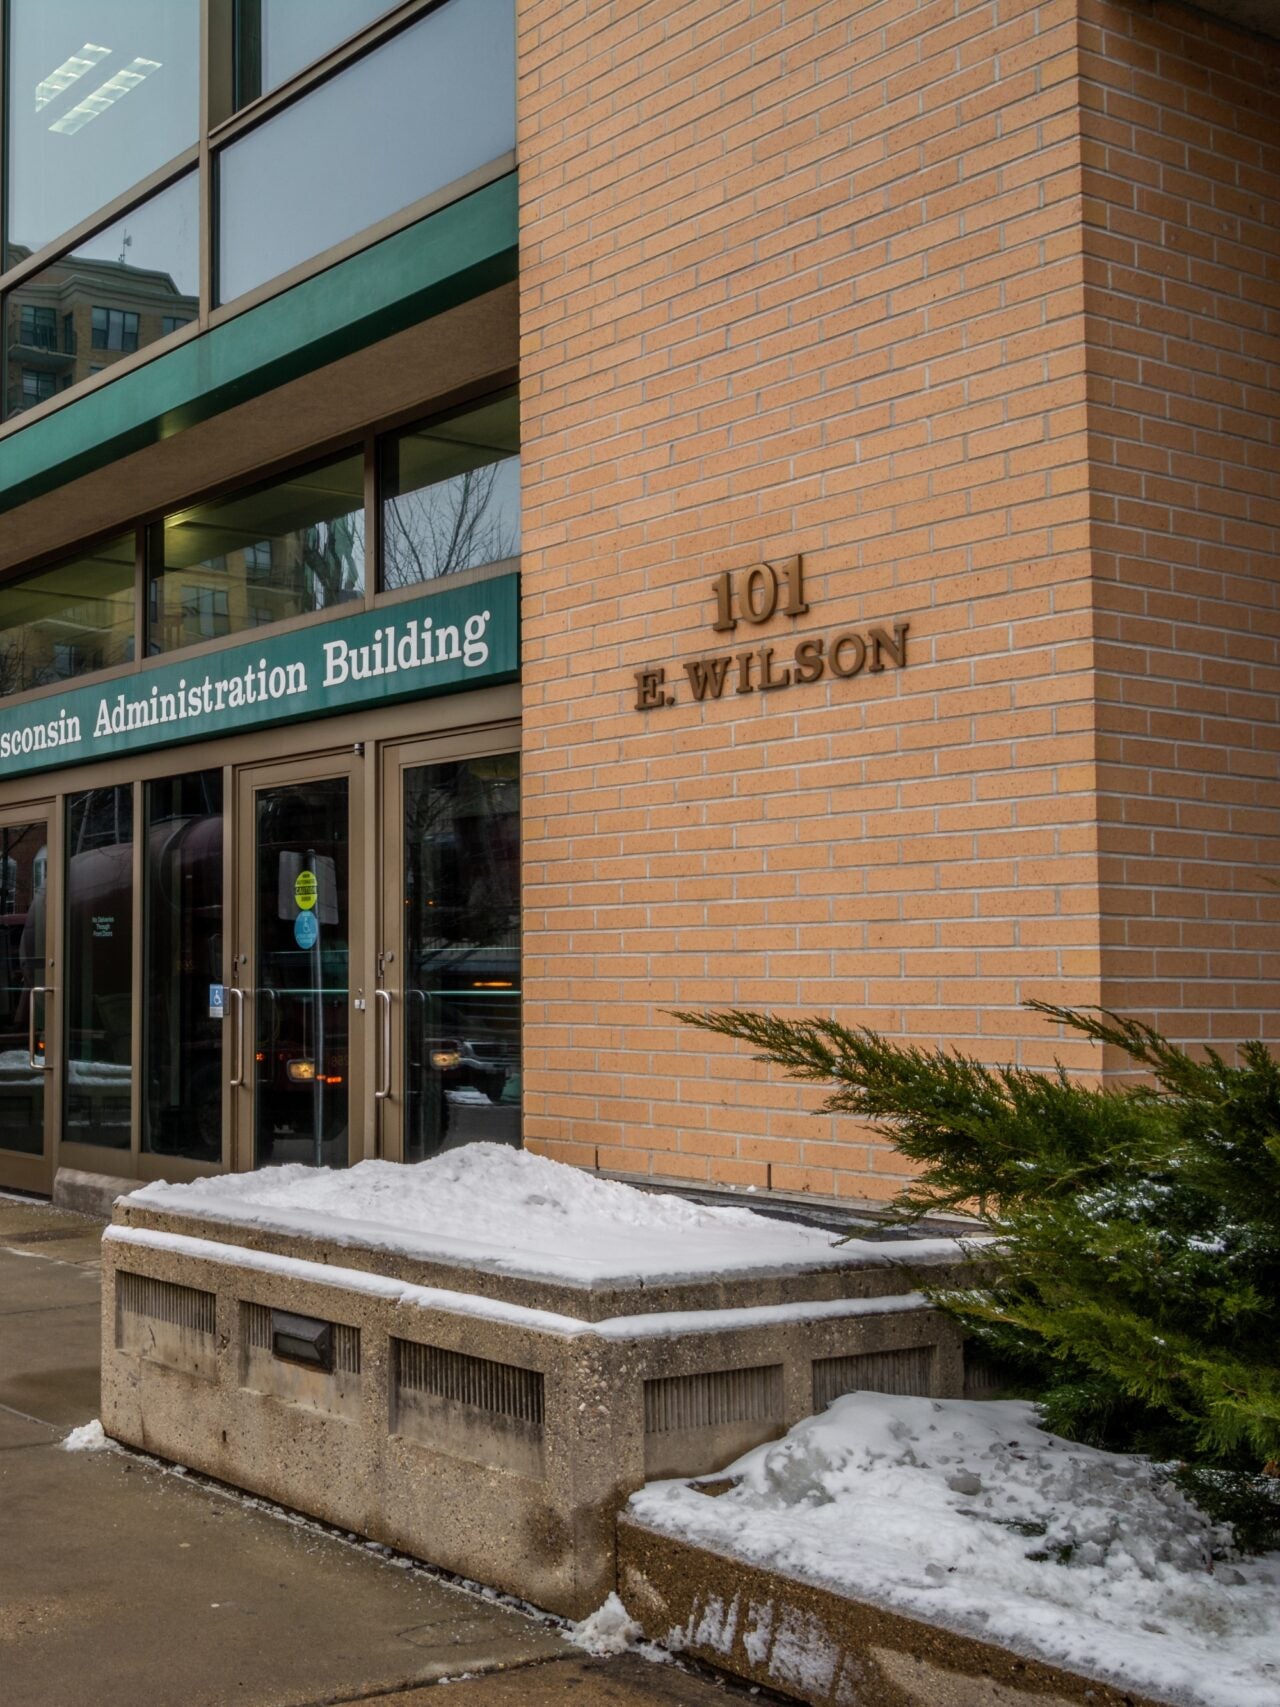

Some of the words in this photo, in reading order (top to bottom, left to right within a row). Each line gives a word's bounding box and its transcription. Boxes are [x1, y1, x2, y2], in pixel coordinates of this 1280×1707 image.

[711, 553, 809, 632] 101
[93, 658, 308, 738] Administration
[322, 609, 491, 687] Building
[682, 622, 910, 701] WILSON
